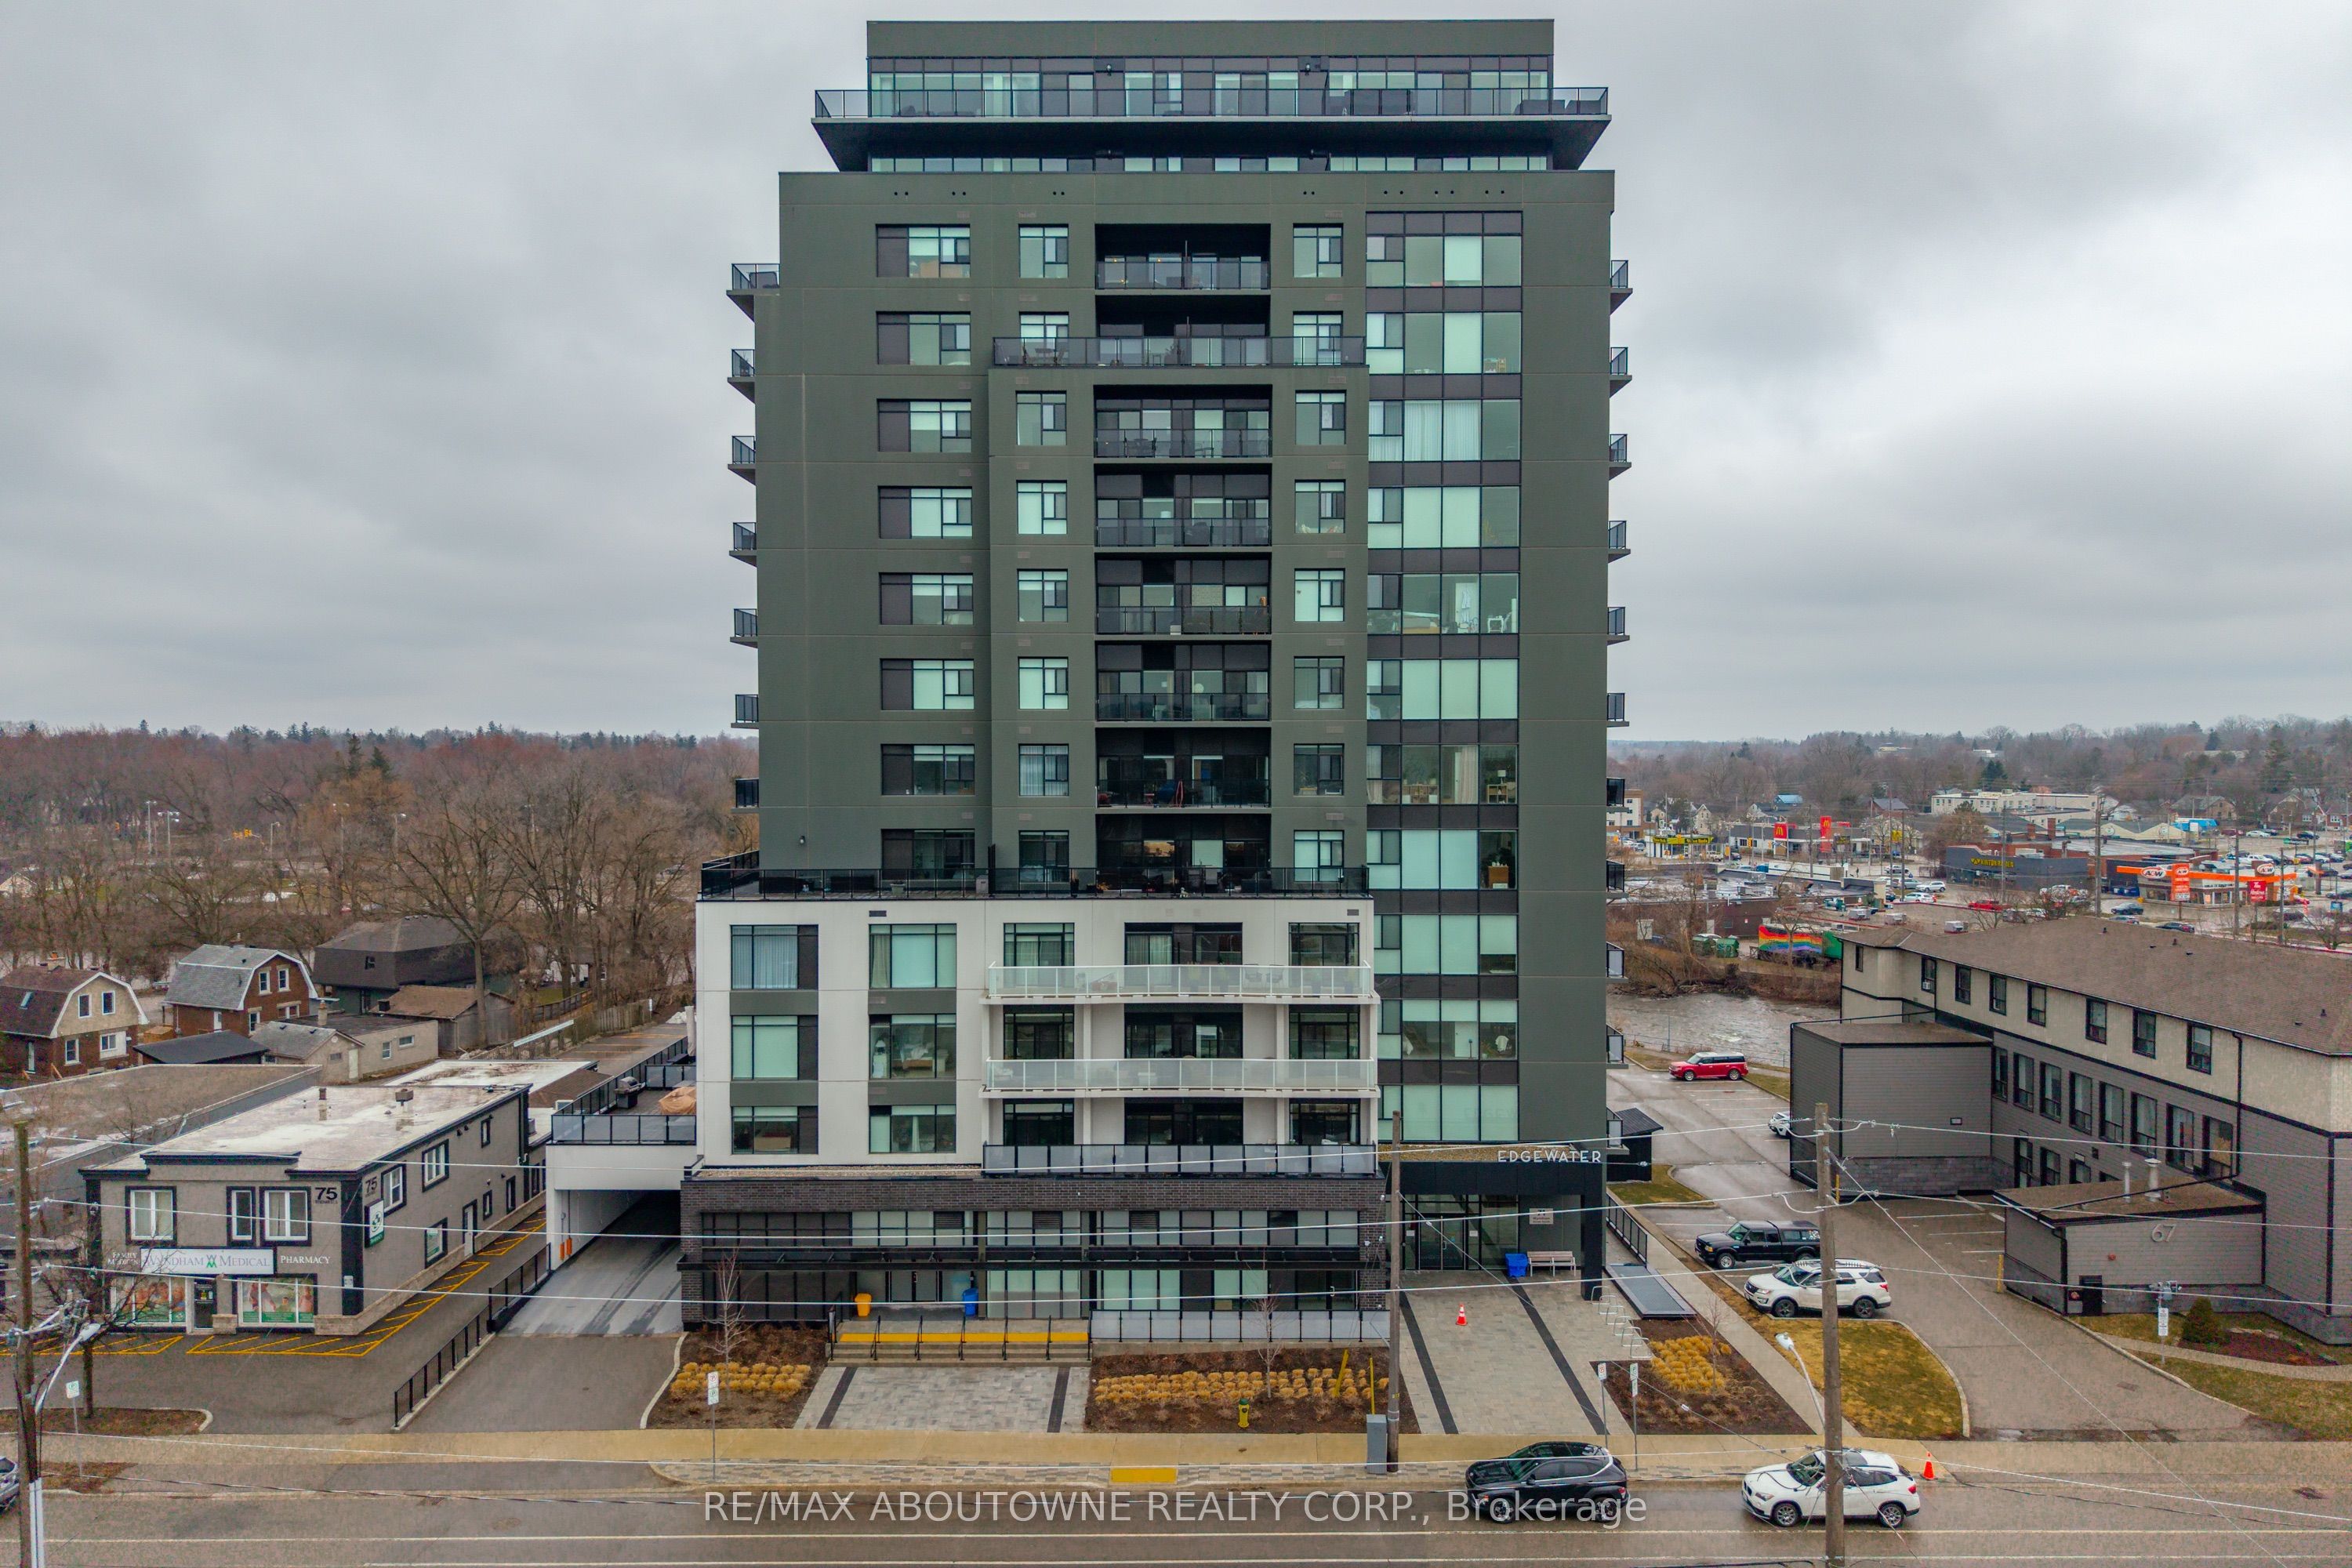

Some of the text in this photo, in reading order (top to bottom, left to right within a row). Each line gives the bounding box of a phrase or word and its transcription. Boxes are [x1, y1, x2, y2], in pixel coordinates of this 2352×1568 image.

[1497, 1150, 1602, 1163] EDGEWATER
[365, 1177, 378, 1193] 75
[315, 1187, 338, 1200] 75
[2151, 1224, 2177, 1243] 67
[220, 1256, 270, 1266] MEDICAL
[280, 1255, 331, 1264] PHARMACY
